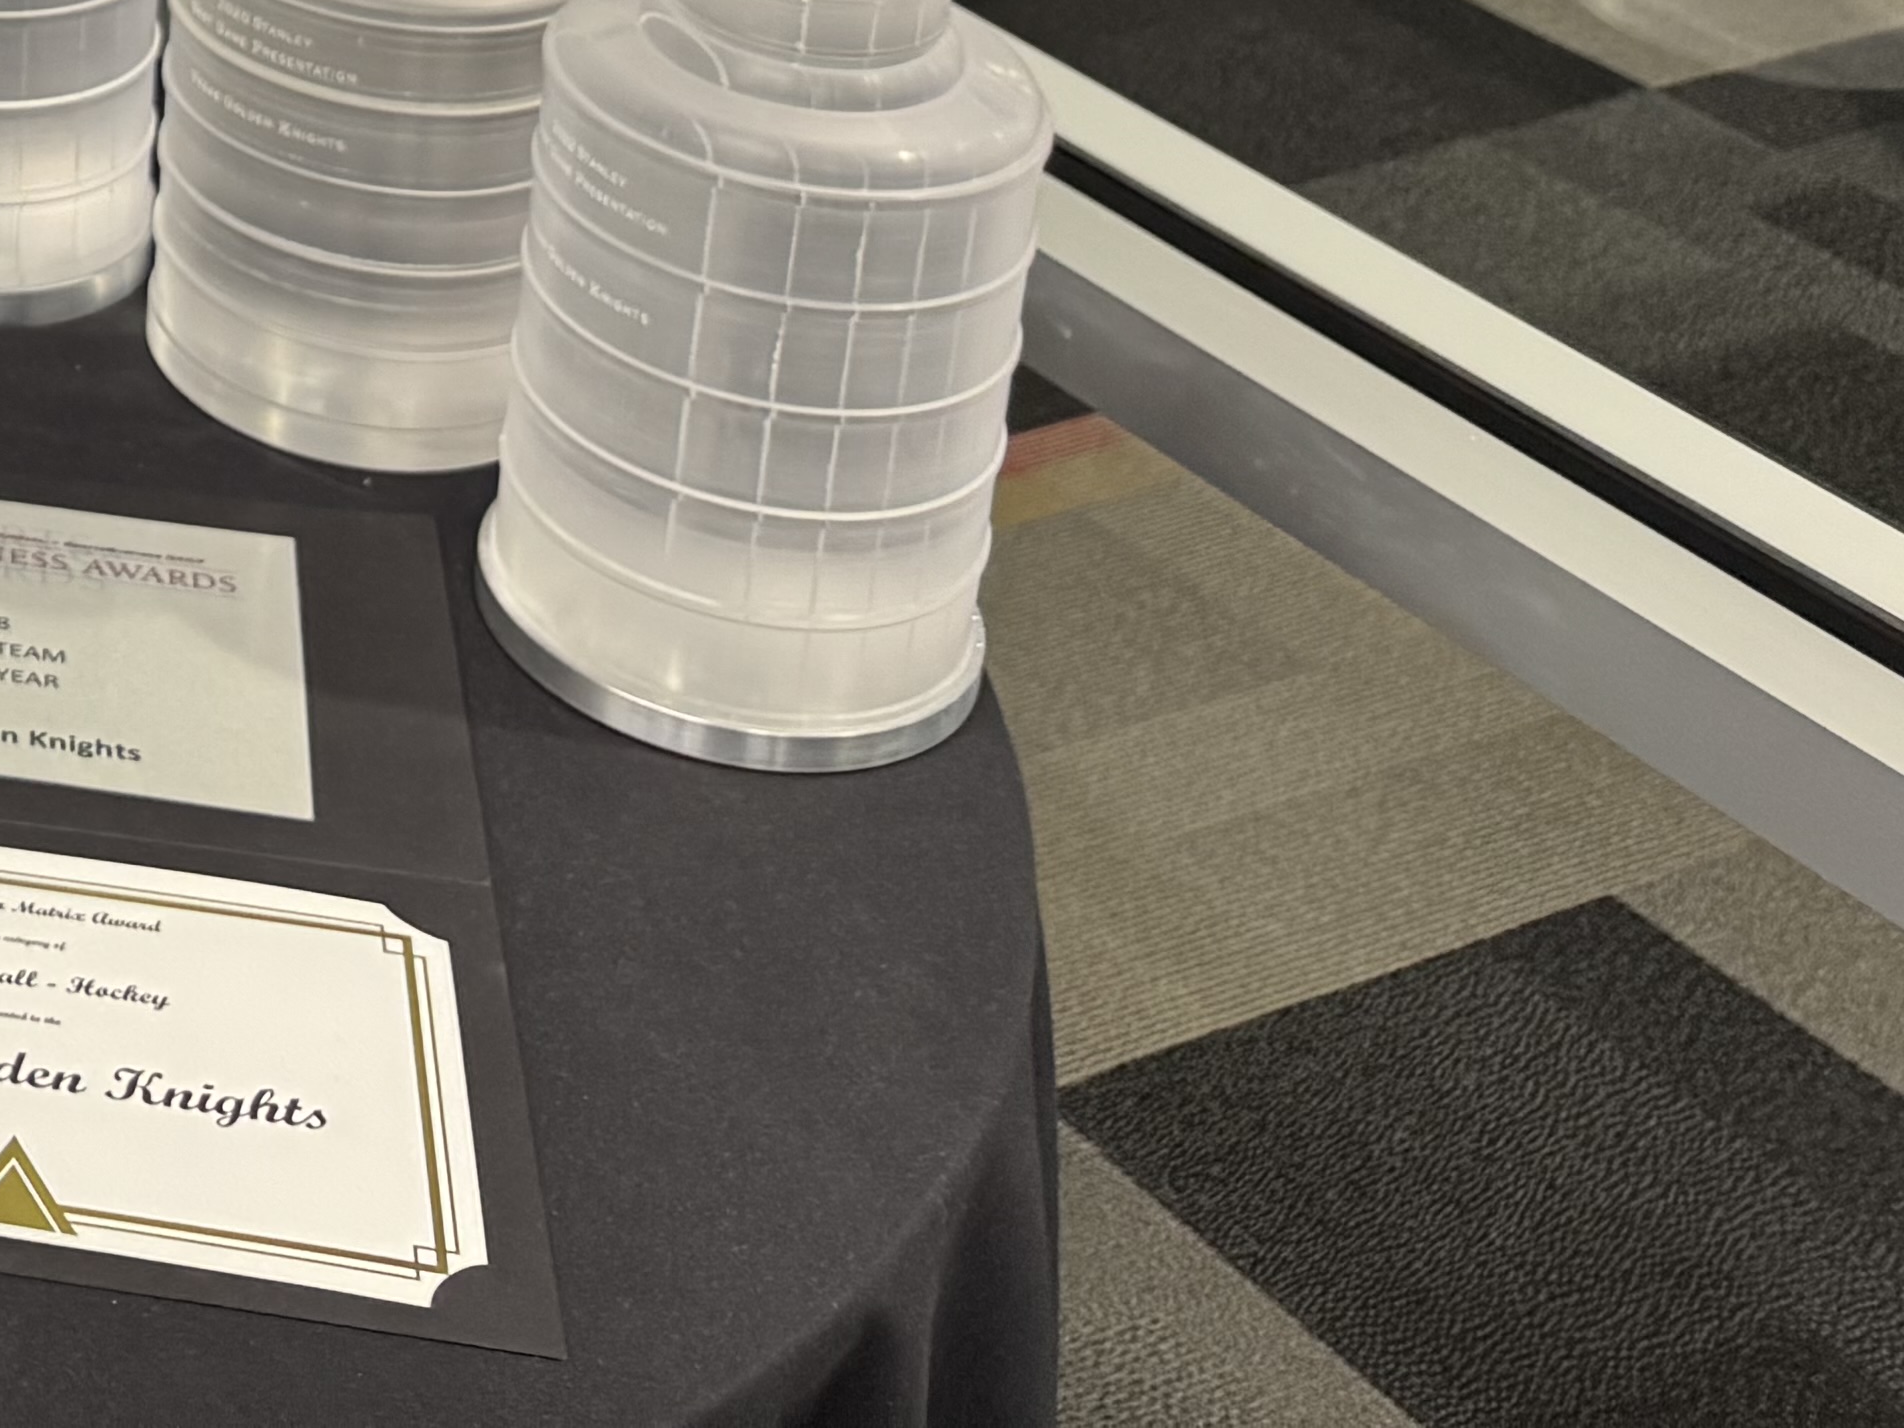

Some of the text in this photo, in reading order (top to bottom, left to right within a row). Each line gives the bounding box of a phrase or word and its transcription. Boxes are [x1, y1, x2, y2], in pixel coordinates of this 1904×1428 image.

[81, 558, 238, 594] AWARDS
[28, 730, 143, 762] Knights
[11, 899, 87, 922] Matrix
[91, 911, 163, 933] Award
[65, 974, 171, 1011] Hockey
[104, 1065, 328, 1131] Knights
